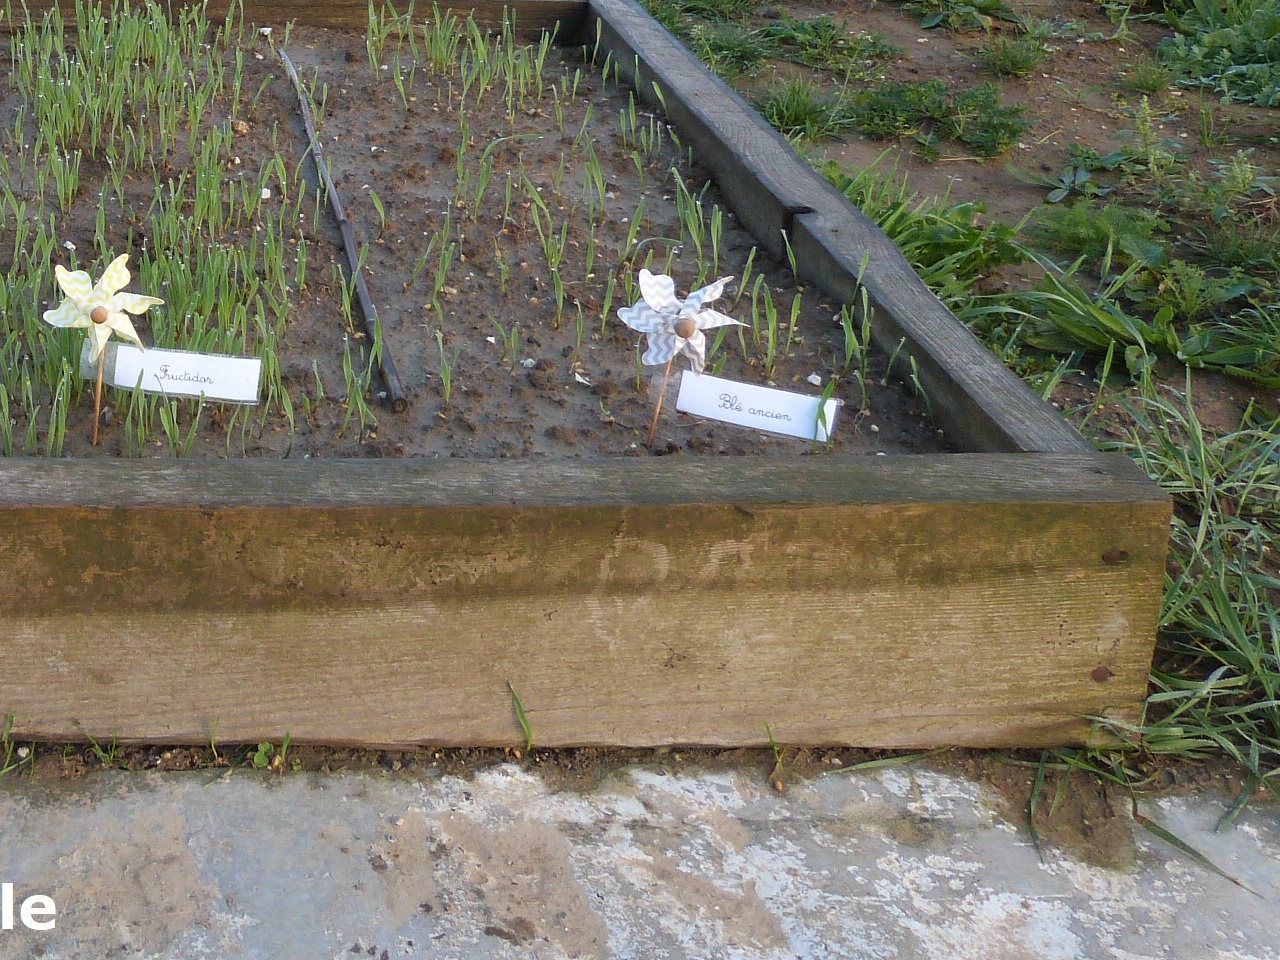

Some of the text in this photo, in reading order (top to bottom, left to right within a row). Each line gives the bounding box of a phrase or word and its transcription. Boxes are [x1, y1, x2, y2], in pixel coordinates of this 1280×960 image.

[158, 364, 215, 385] Fructidor
[718, 393, 792, 422] Blé ancien
